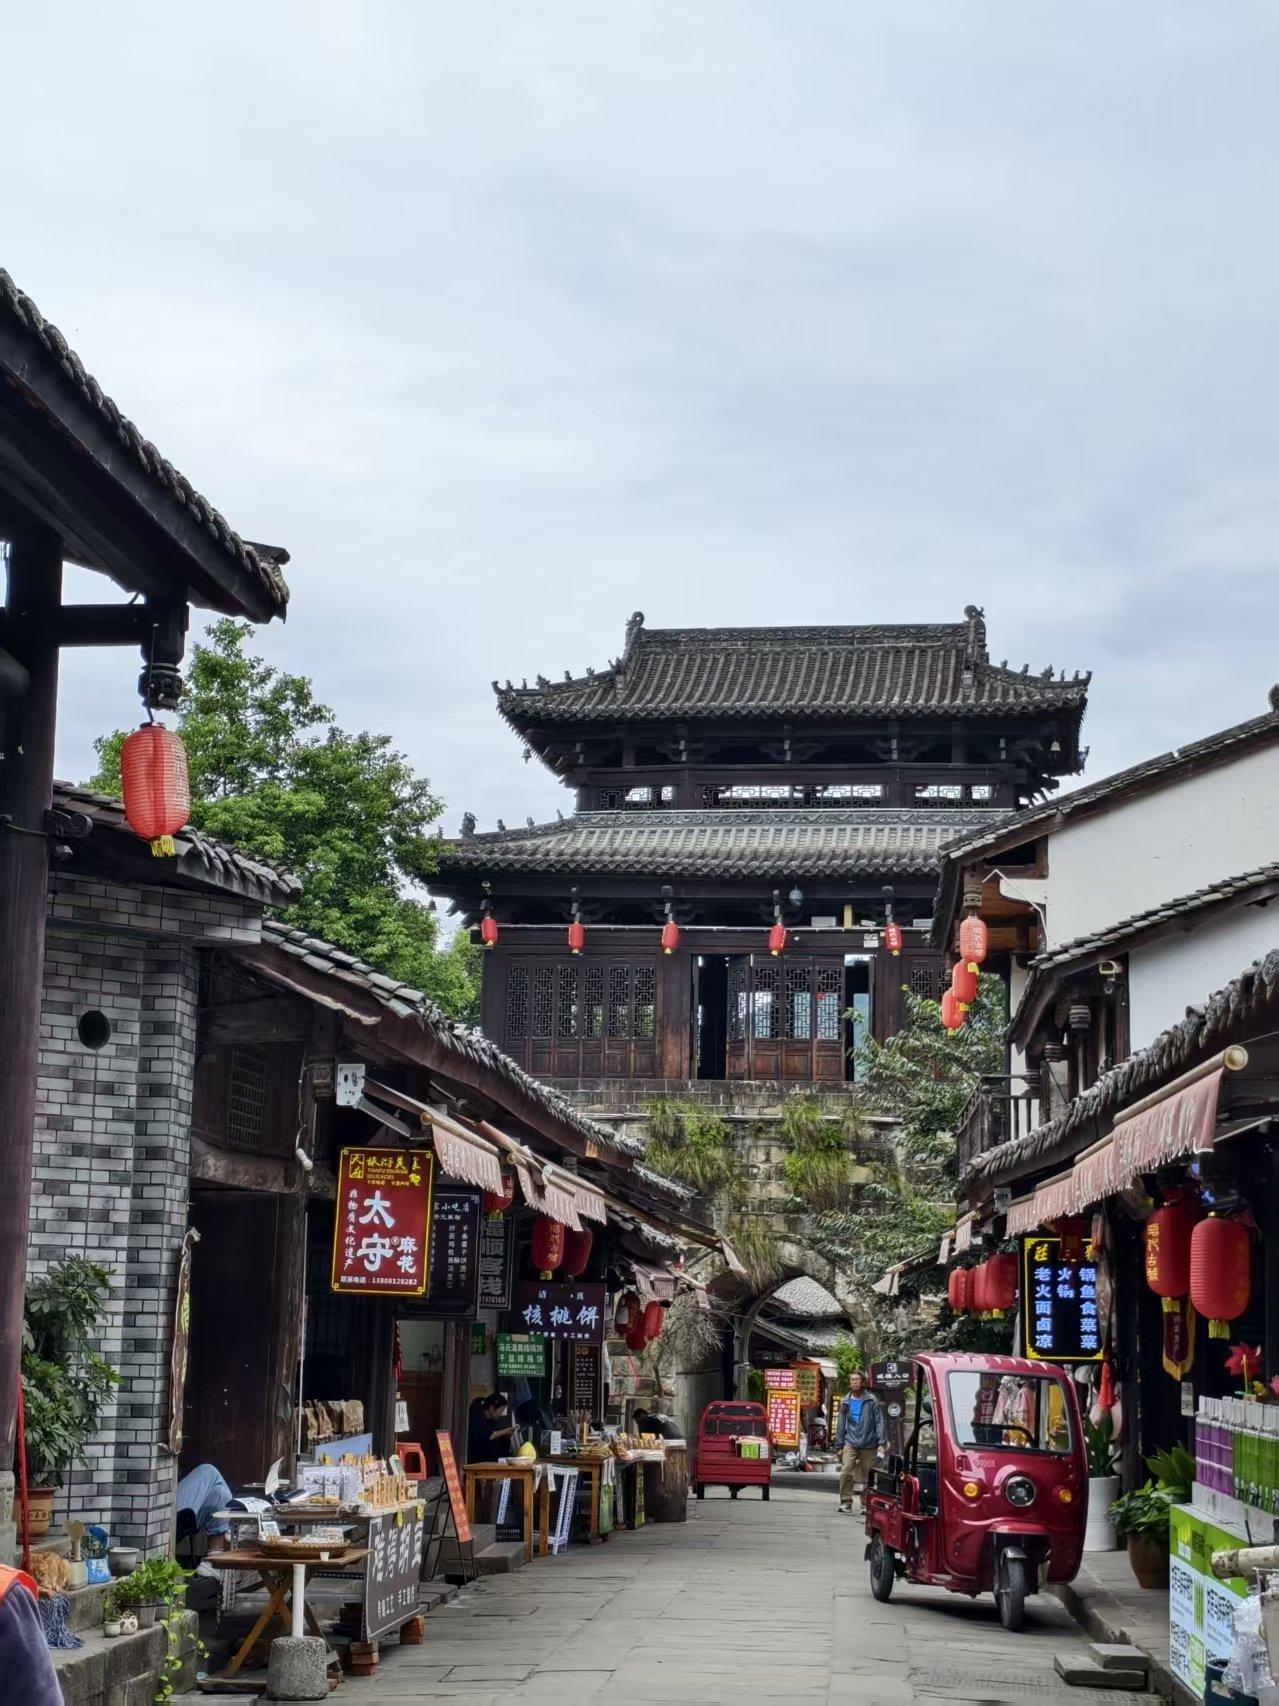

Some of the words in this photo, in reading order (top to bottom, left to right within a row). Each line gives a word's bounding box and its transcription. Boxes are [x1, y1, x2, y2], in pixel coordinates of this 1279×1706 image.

[397, 1236, 418, 1274] 麻花
[522, 1303, 600, 1330] 核桃饼
